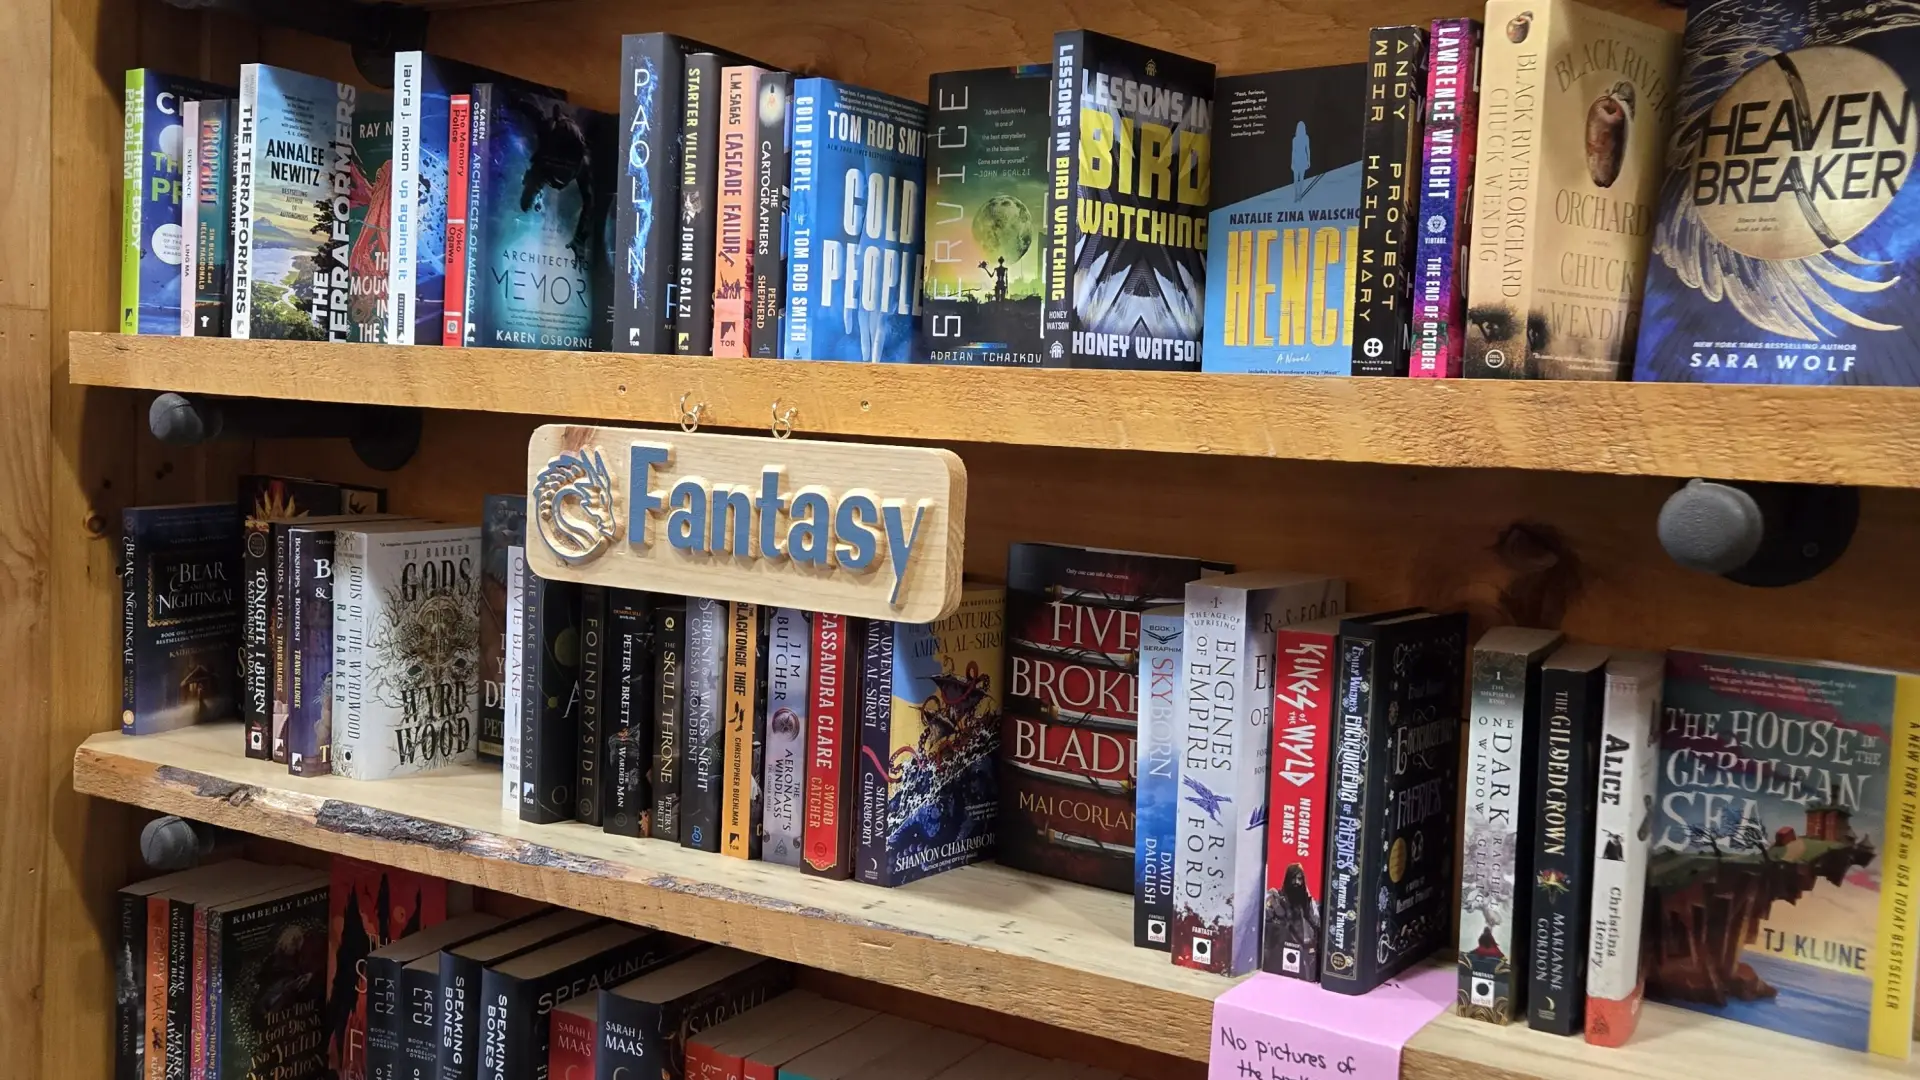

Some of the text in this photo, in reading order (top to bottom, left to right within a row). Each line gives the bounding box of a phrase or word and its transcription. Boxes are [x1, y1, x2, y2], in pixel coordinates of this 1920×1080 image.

[402, 64, 413, 107] laura
[1080, 68, 1184, 123] LESSONS
[1371, 40, 1388, 121] WEIR
[1392, 39, 1409, 120] ANDY
[1554, 37, 1674, 123] BLACK RIVER
[123, 88, 135, 180] PROBLEM
[241, 105, 253, 145] THE
[452, 109, 461, 143] Police
[456, 108, 468, 177] The Memory
[478, 108, 487, 140] KAREN
[683, 67, 701, 186] STARTER VILLAIN
[827, 109, 927, 159] TOM ROB SMIT
[1428, 26, 1461, 199] LAWRENCE WRIGHT
[1701, 90, 1913, 157] HEAVEN
[264, 138, 325, 167] ANNALEE
[270, 160, 320, 187] NEWITZ
[401, 126, 411, 172] mixon
[1051, 44, 1074, 302] LESSONS IN BIRD WATCHING
[1078, 106, 1212, 208] BIRD
[1501, 53, 1537, 298] BLACK RIVER ORCHARD
[1692, 150, 1908, 206] BREAKER
[281, 188, 308, 198] BESTSELLING
[311, 83, 356, 343] THE TERRAFORMERS
[399, 179, 409, 199] up
[467, 101, 481, 314] OSBORNE ARCHITECTS OF MEMORY
[628, 68, 651, 310] PAOLINI
[718, 132, 744, 268] CASCADE FAILURE
[771, 187, 779, 208] THE
[791, 96, 814, 342] COLD PEOPLE TOM ROB SMITH
[843, 168, 918, 245] COLD
[932, 85, 969, 338] SERVICE
[235, 147, 252, 314] TERRAFORMERS
[398, 203, 408, 264] against
[456, 227, 464, 253] Yoko
[1076, 198, 1208, 250] WATCHING
[1359, 155, 1381, 322] HAIL MARY
[1381, 163, 1402, 311] PROJECT
[1424, 237, 1447, 245] VINTAGE
[398, 269, 407, 281] it
[679, 226, 694, 319] JOHN SCALZI
[1559, 249, 1637, 294] CHUCK
[495, 329, 593, 349] KAREN OSBORNE
[1046, 321, 1070, 331] WATSON
[1048, 310, 1068, 320] HONEY
[1421, 256, 1442, 370] THE END OF OCTOBER
[720, 340, 736, 348] TOR
[1689, 352, 1857, 372] SARA WOLF
[1692, 341, 1857, 351] NEW YORK TIMES BESTSELLING AUTHOR
[627, 443, 928, 605] Fantasy
[347, 566, 363, 740] GODS OF THE WYRDWOOD
[733, 602, 748, 697] BLACKTONGUE THIEF
[1046, 601, 1140, 652] FIVE
[1143, 645, 1182, 653] SERAPHIM
[1149, 624, 1171, 632] BOOK
[662, 650, 676, 705] SKULL
[774, 615, 789, 701] BUTCHER
[789, 643, 802, 678] JIM
[688, 618, 700, 764] CARISSA BROADBENT
[1148, 657, 1175, 779] SKYBORN
[1186, 635, 1212, 771] OF EMPIRE
[1211, 638, 1238, 772] ENGINES
[660, 709, 675, 784] THRONE
[816, 715, 835, 770] CLARE
[1665, 706, 1860, 767] THE HOUSE
[1854, 749, 1883, 766] THE
[1860, 735, 1880, 749] IN
[616, 746, 627, 808] WARDED MAN
[731, 737, 742, 827] CHRISTOPHER BUEHLMAN
[772, 758, 784, 819] WINDLASS
[782, 748, 794, 832] AERONAUT'S
[793, 781, 801, 799] THE
[1474, 738, 1488, 815] WINDOW
[1488, 732, 1513, 826] DARK
[1543, 690, 1572, 856] THE GILDED CROWN
[1601, 733, 1631, 806] ALICE
[1666, 747, 1873, 813] CERULEAN
[809, 776, 822, 828] CATCHER
[823, 783, 835, 826] SWORD
[1282, 803, 1296, 846] EAMES
[1297, 797, 1312, 858] NICHOLAS
[1655, 790, 1769, 853] SEA
[1144, 837, 1157, 905] DALGLISH
[1159, 851, 1172, 896] DAVID
[1185, 816, 1206, 899] FORD
[1885, 721, 1920, 1010] A NEW YORK TIMES AND USA TODAY BESTSELLER
[1191, 925, 1214, 936] FANTASY
[1535, 917, 1549, 982] GORDON
[1549, 912, 1566, 991] MARIANNE
[1591, 919, 1607, 969] Henry
[1606, 886, 1623, 958] Christina
[1762, 928, 1868, 971] TJ KLUNE
[374, 977, 385, 1014] LIU
[385, 978, 395, 1016] KEN
[412, 987, 423, 1024] LIU
[423, 989, 433, 1027] KEN
[443, 986, 454, 1048] BONES
[453, 975, 465, 1065] SPEAKING
[485, 1004, 497, 1069] BONES
[557, 1021, 586, 1038] SARAH
[557, 1035, 592, 1057] MAAS
[605, 1020, 645, 1041] SARAH J.
[605, 1034, 644, 1058] MAAS
[1220, 1026, 1247, 1051] No
[1255, 1039, 1327, 1070] pictures
[1336, 1055, 1357, 1075] of
[1236, 1059, 1263, 1080] the
